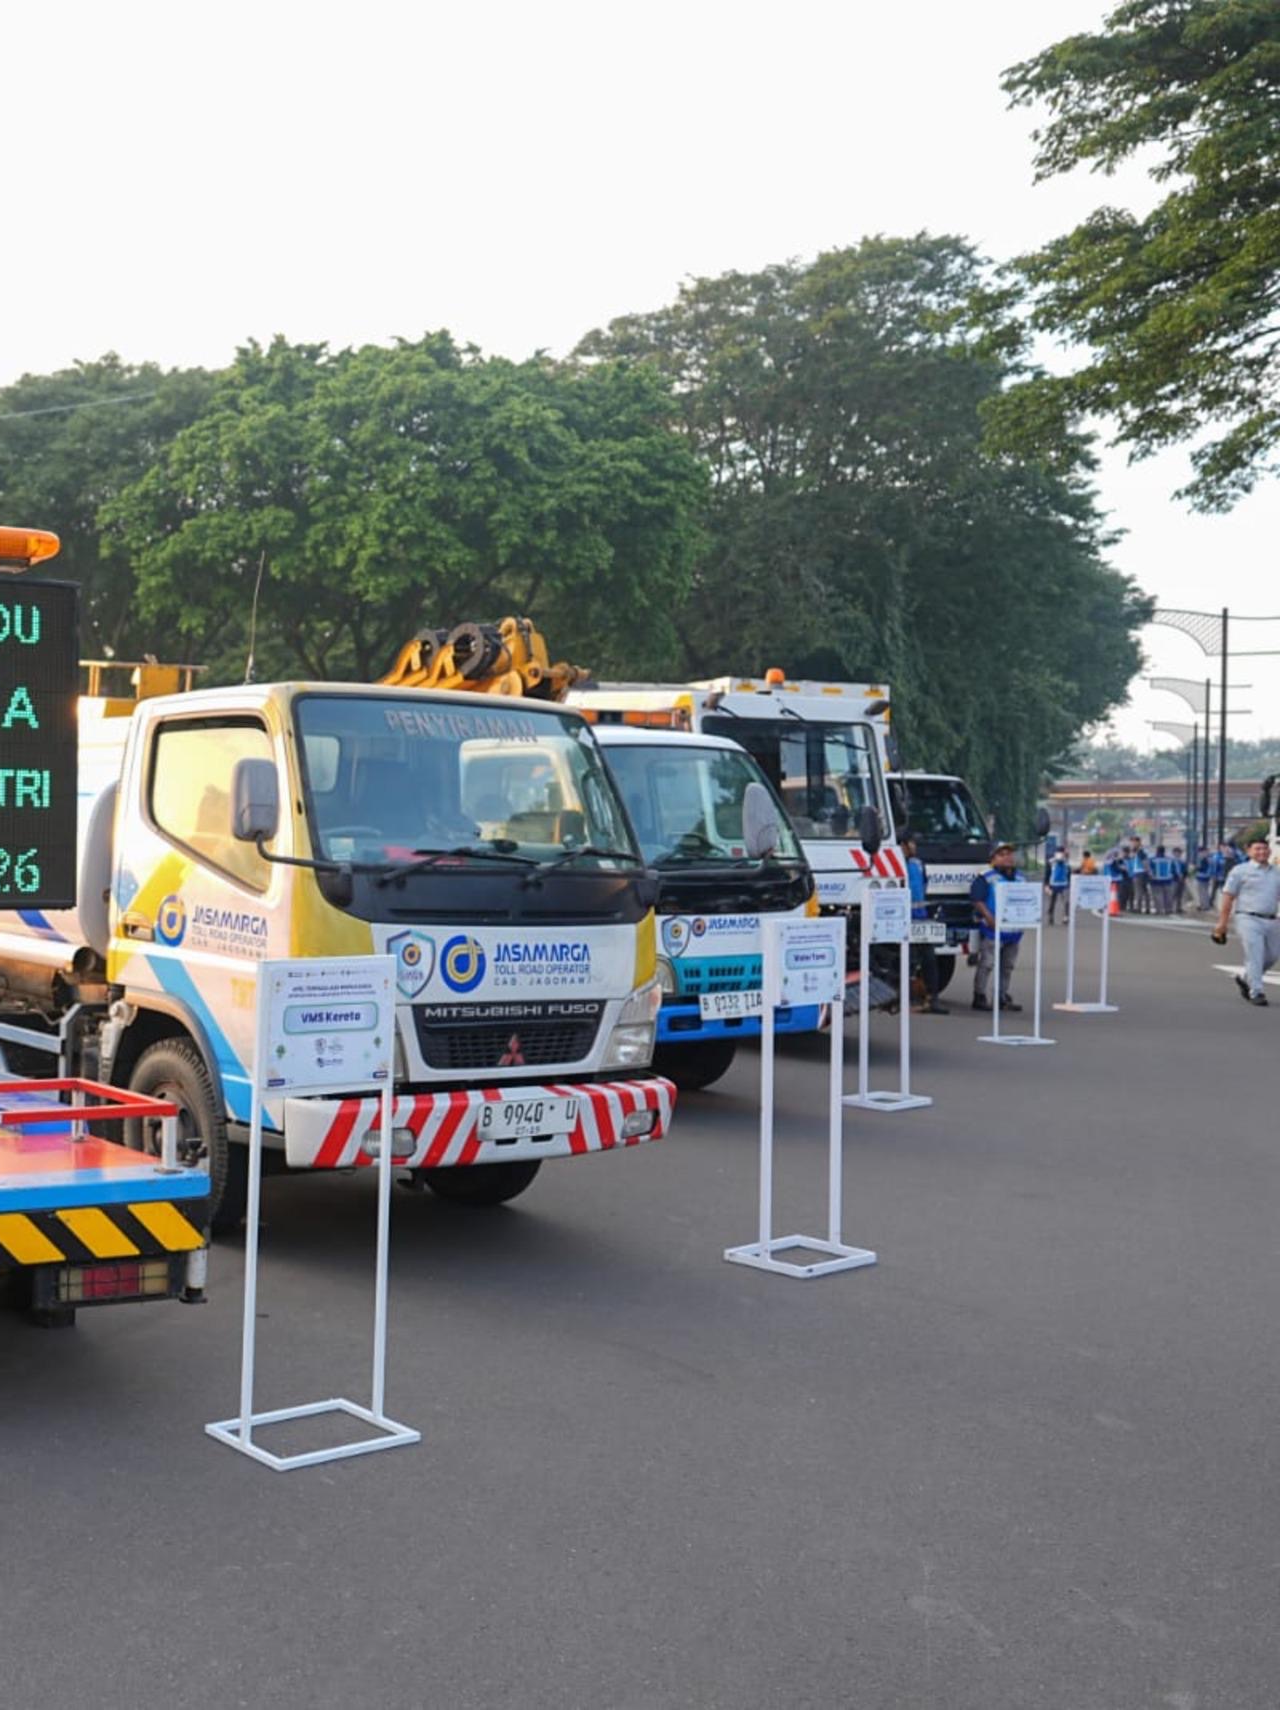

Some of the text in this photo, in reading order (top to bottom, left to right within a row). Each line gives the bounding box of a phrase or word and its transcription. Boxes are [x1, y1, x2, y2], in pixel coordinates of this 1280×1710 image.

[384, 709, 538, 742] PENYIRAMAN
[192, 905, 269, 937] JASAMARGA
[494, 943, 591, 962] JASAMARGA
[495, 964, 592, 975] TOLL ROAD OPERATOR
[301, 1012, 324, 1024] VMS
[425, 1003, 600, 1018] MITSUBISHI FUSO
[482, 1105, 493, 1127] B
[504, 1101, 544, 1126] 9940
